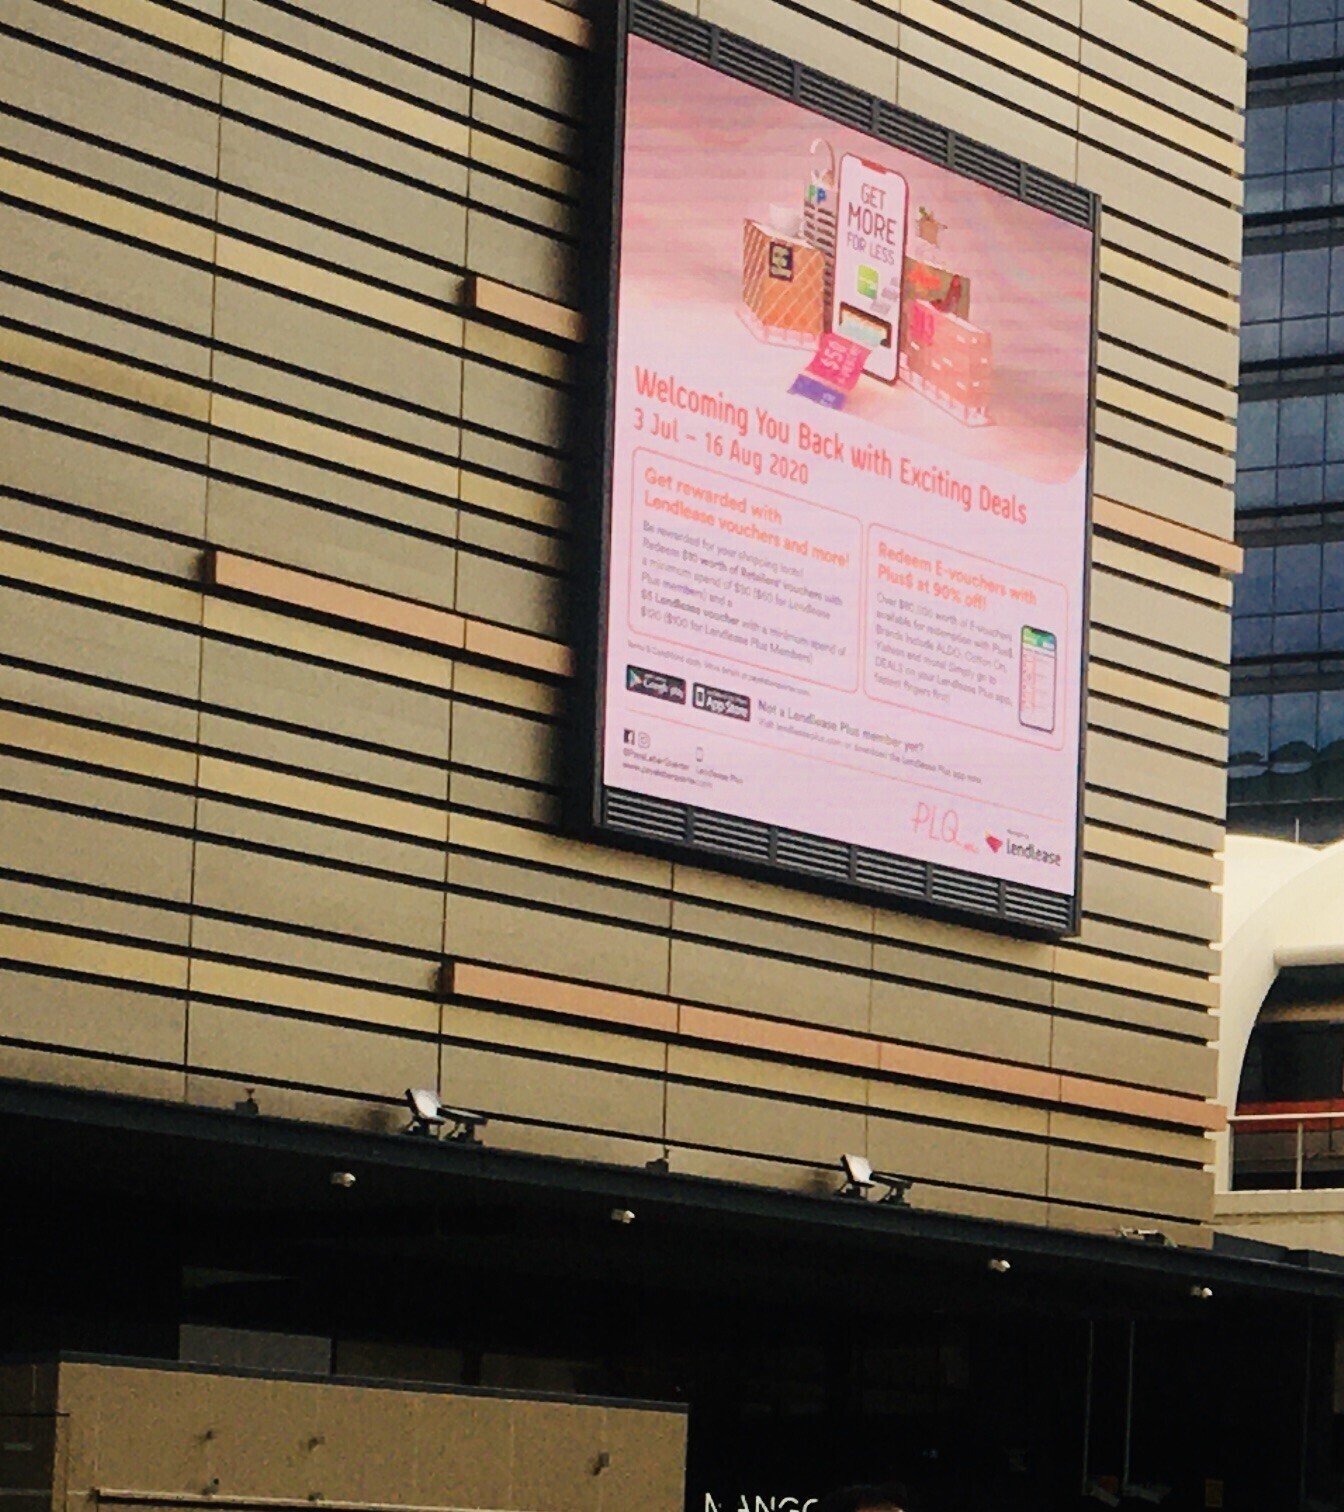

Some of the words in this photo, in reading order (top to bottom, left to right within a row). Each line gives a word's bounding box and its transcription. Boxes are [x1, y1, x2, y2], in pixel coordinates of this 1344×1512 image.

[861, 181, 886, 212] GET
[846, 232, 866, 254] FOR
[869, 241, 894, 265] LESS
[847, 201, 896, 246] MORE
[633, 406, 644, 432] 3
[650, 409, 679, 443] Jul
[705, 430, 723, 458] 16
[729, 437, 762, 476] Aug
[769, 451, 808, 485] 2020
[634, 362, 748, 438] Welcoming
[756, 406, 789, 445] You
[798, 419, 843, 463] Back
[850, 443, 892, 479] with
[900, 454, 971, 513] Exciting
[979, 483, 1026, 525] Deals
[645, 465, 672, 490] Get
[676, 480, 746, 514] rewarded
[751, 504, 782, 525] with
[644, 489, 714, 527] Lendlease
[719, 517, 780, 547] vouchers
[783, 537, 807, 556] and
[878, 541, 931, 573] Redeem
[935, 559, 1005, 596] E-vouchers
[1009, 587, 1036, 606] with
[917, 579, 929, 593] at
[933, 580, 961, 604] 90%
[757, 699, 776, 713] Not
[787, 707, 836, 729] Lendlease
